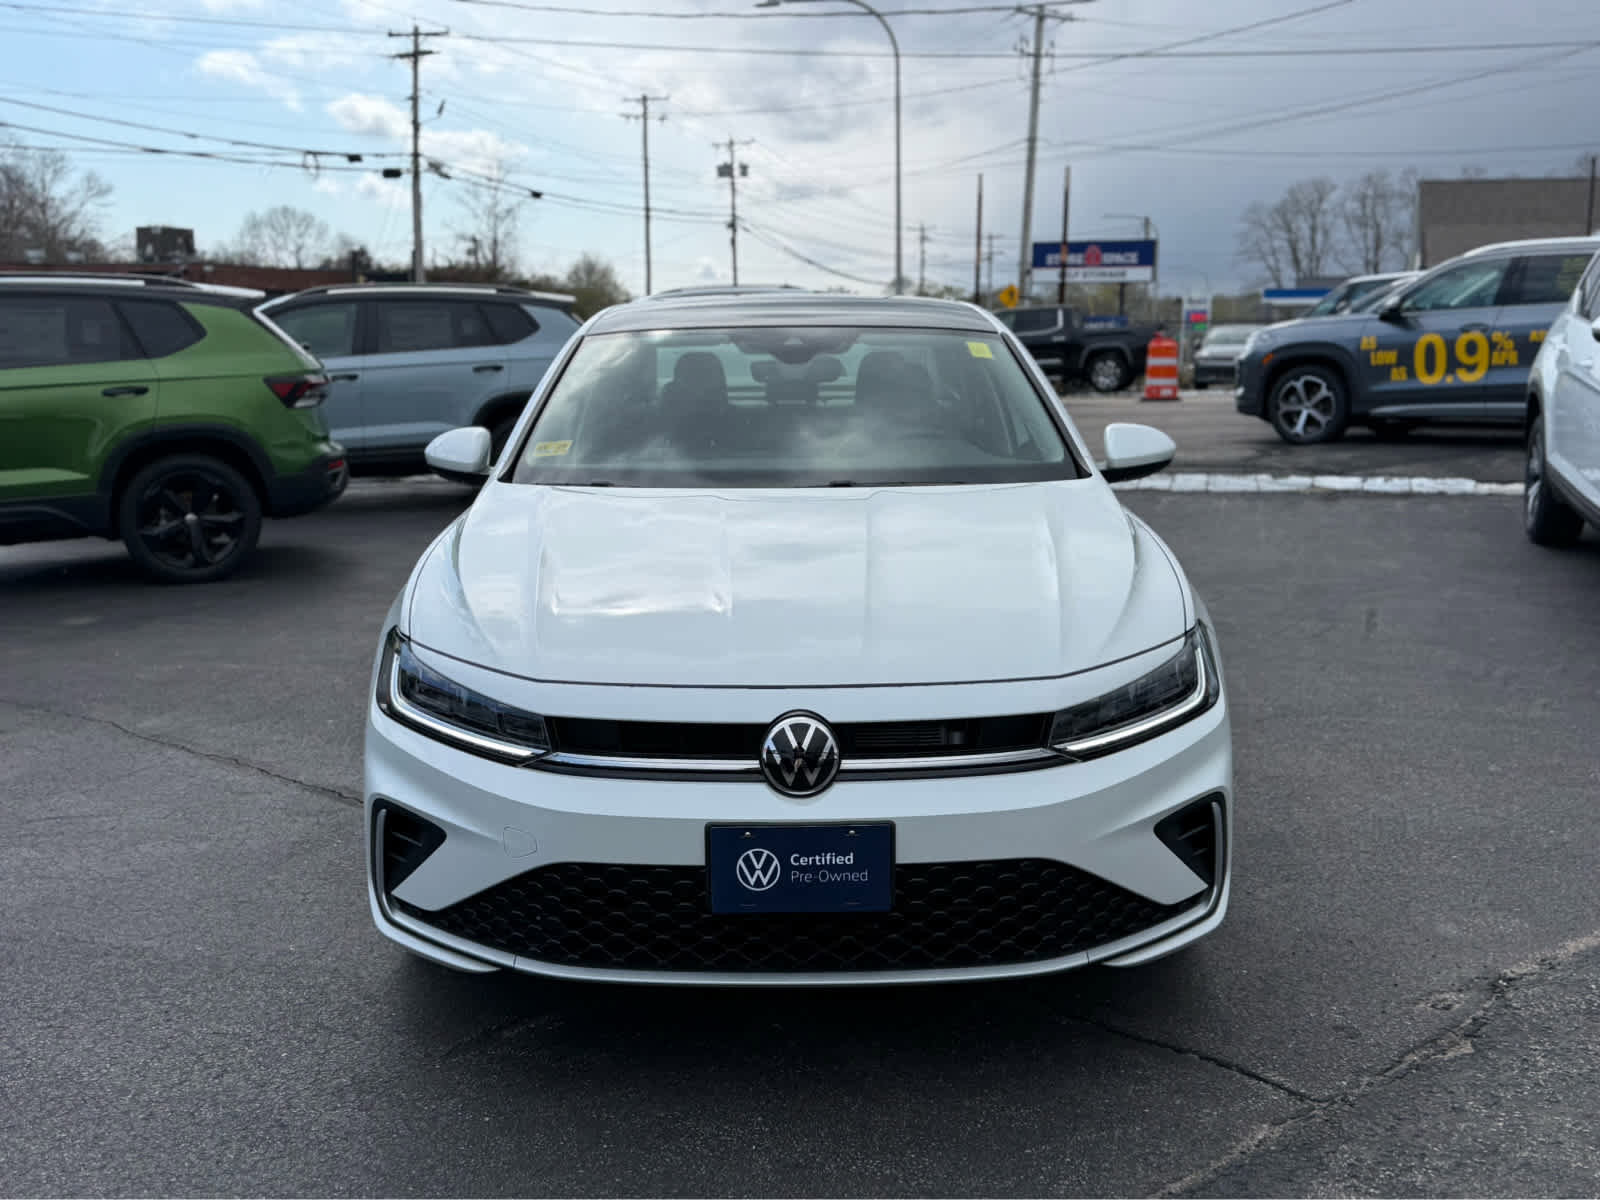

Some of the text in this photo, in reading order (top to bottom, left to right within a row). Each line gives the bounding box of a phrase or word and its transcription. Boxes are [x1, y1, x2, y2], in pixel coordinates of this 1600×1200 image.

[1046, 253, 1083, 265] STRE
[1360, 336, 1377, 351] AS
[1371, 350, 1398, 366] LOW
[1491, 350, 1519, 366] APR
[1390, 366, 1408, 382] AS
[764, 716, 838, 794] VW
[790, 852, 854, 866] Certified
[736, 848, 781, 892] VW
[791, 869, 868, 883] Pre-Owned
